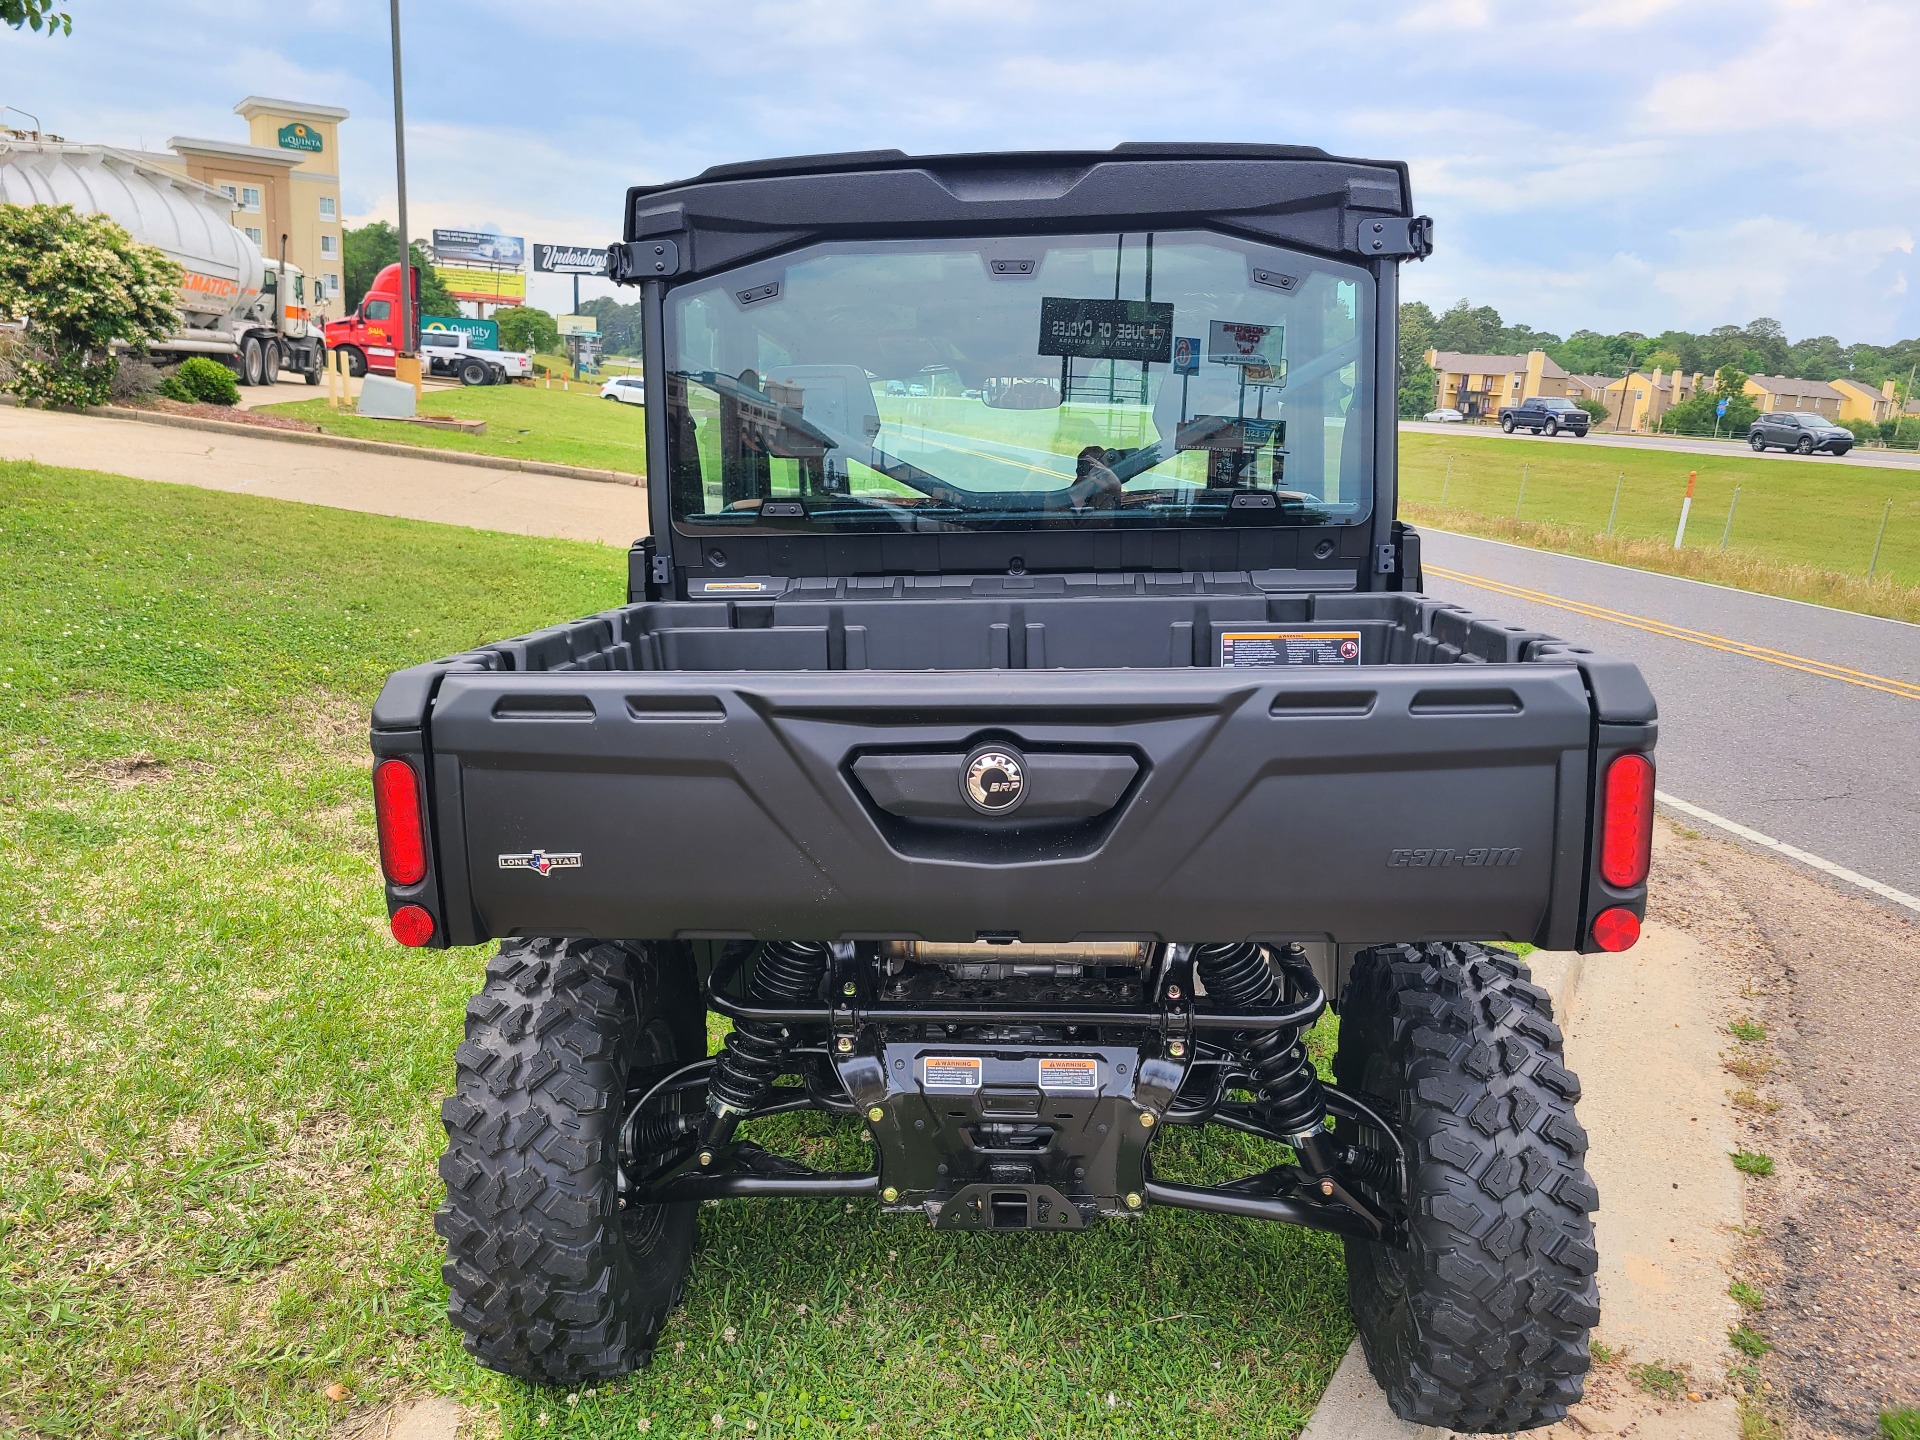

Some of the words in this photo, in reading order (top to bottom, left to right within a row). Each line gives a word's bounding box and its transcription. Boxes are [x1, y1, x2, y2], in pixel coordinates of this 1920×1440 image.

[287, 136, 321, 147] QUINTA
[542, 245, 608, 271] Underdogs
[183, 269, 229, 297] KMATIC
[450, 323, 491, 339] Quality
[989, 781, 1020, 792] BRP
[550, 857, 577, 865] STAR
[1385, 847, 1523, 867] can-am
